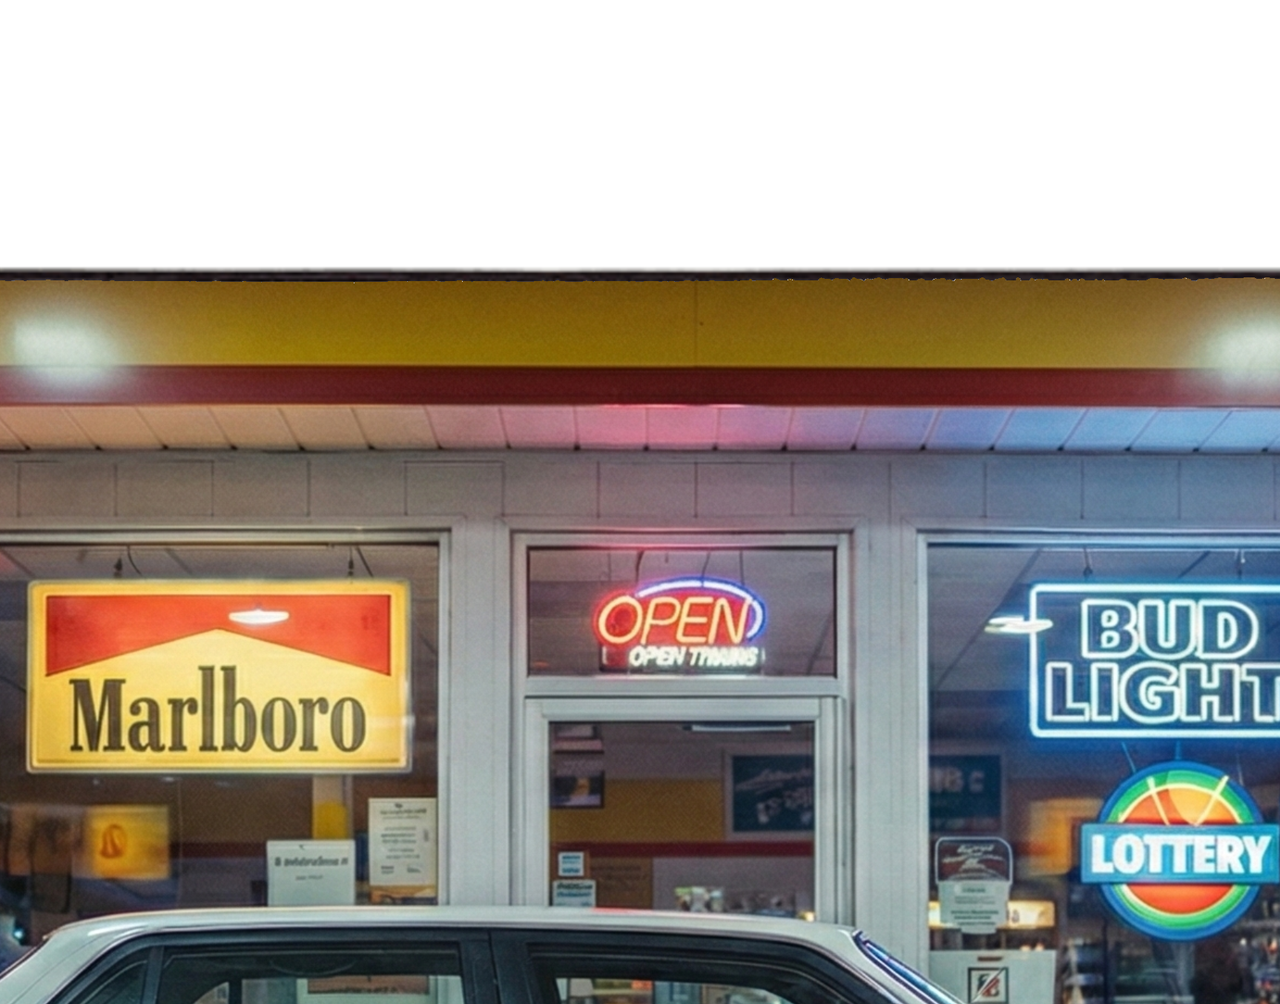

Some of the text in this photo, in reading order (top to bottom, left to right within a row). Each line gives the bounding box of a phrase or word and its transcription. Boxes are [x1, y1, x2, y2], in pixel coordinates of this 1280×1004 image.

[598, 596, 754, 644] OPEN
[1081, 599, 1259, 660] BUD
[628, 646, 686, 666] OPEN
[69, 665, 366, 752] Marlboro
[1091, 834, 1272, 875] LOTTERY
